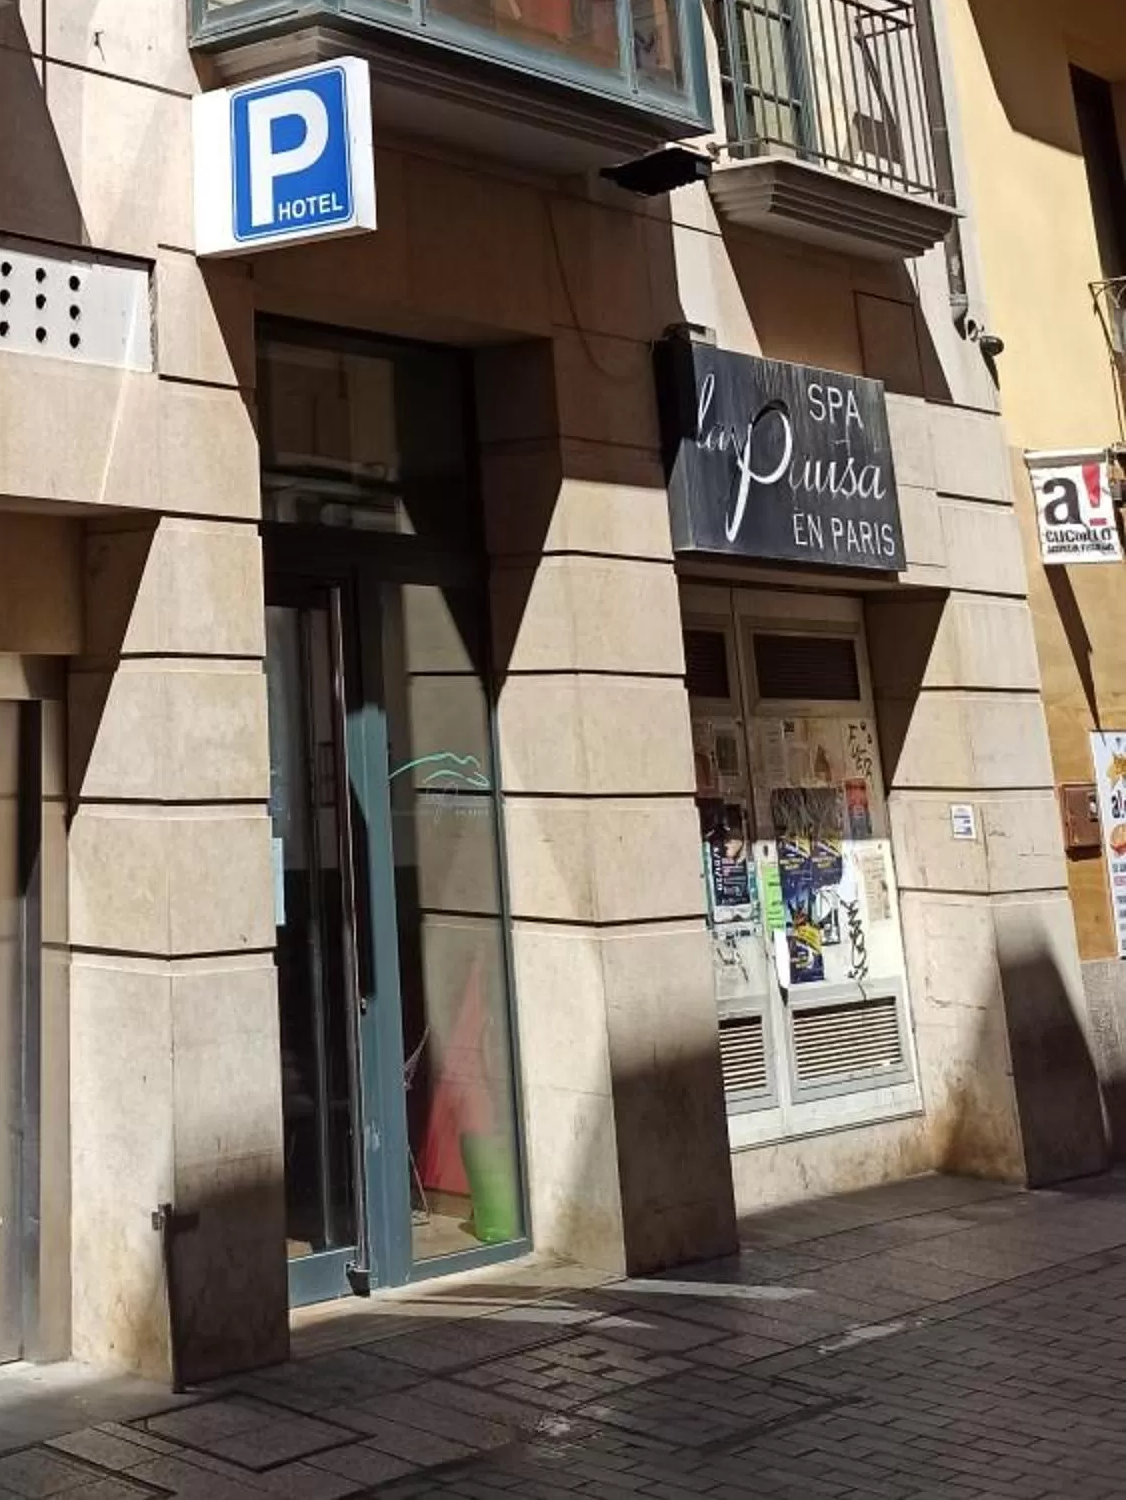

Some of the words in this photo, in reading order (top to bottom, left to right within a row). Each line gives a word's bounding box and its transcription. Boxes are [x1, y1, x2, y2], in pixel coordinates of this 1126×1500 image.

[248, 89, 329, 227] P
[278, 192, 343, 222] HOTEL
[807, 383, 864, 429] SPA
[793, 513, 824, 549] EN
[831, 518, 896, 557] PARIS
